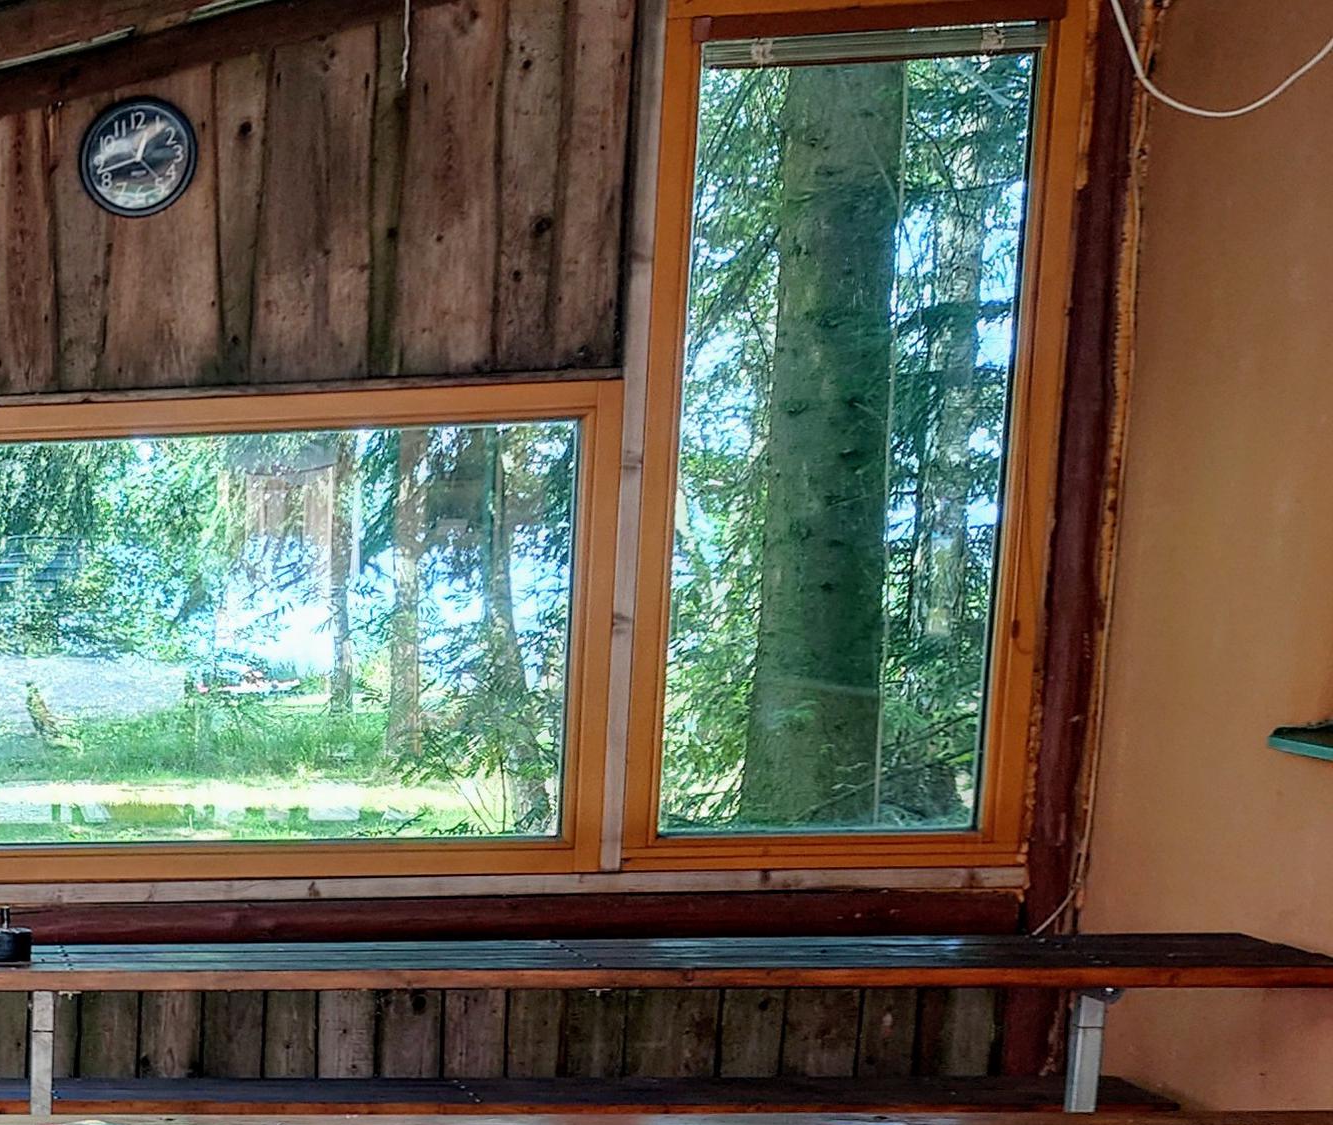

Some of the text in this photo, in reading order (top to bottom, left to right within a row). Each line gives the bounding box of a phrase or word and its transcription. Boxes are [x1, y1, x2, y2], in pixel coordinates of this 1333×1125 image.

[114, 120, 127, 138] 11
[131, 111, 147, 130] 12
[100, 135, 115, 153] 10
[165, 127, 178, 146] 2
[173, 144, 184, 163] 3
[101, 172, 112, 189] 8
[166, 163, 176, 181] 4
[155, 177, 166, 193] 5
